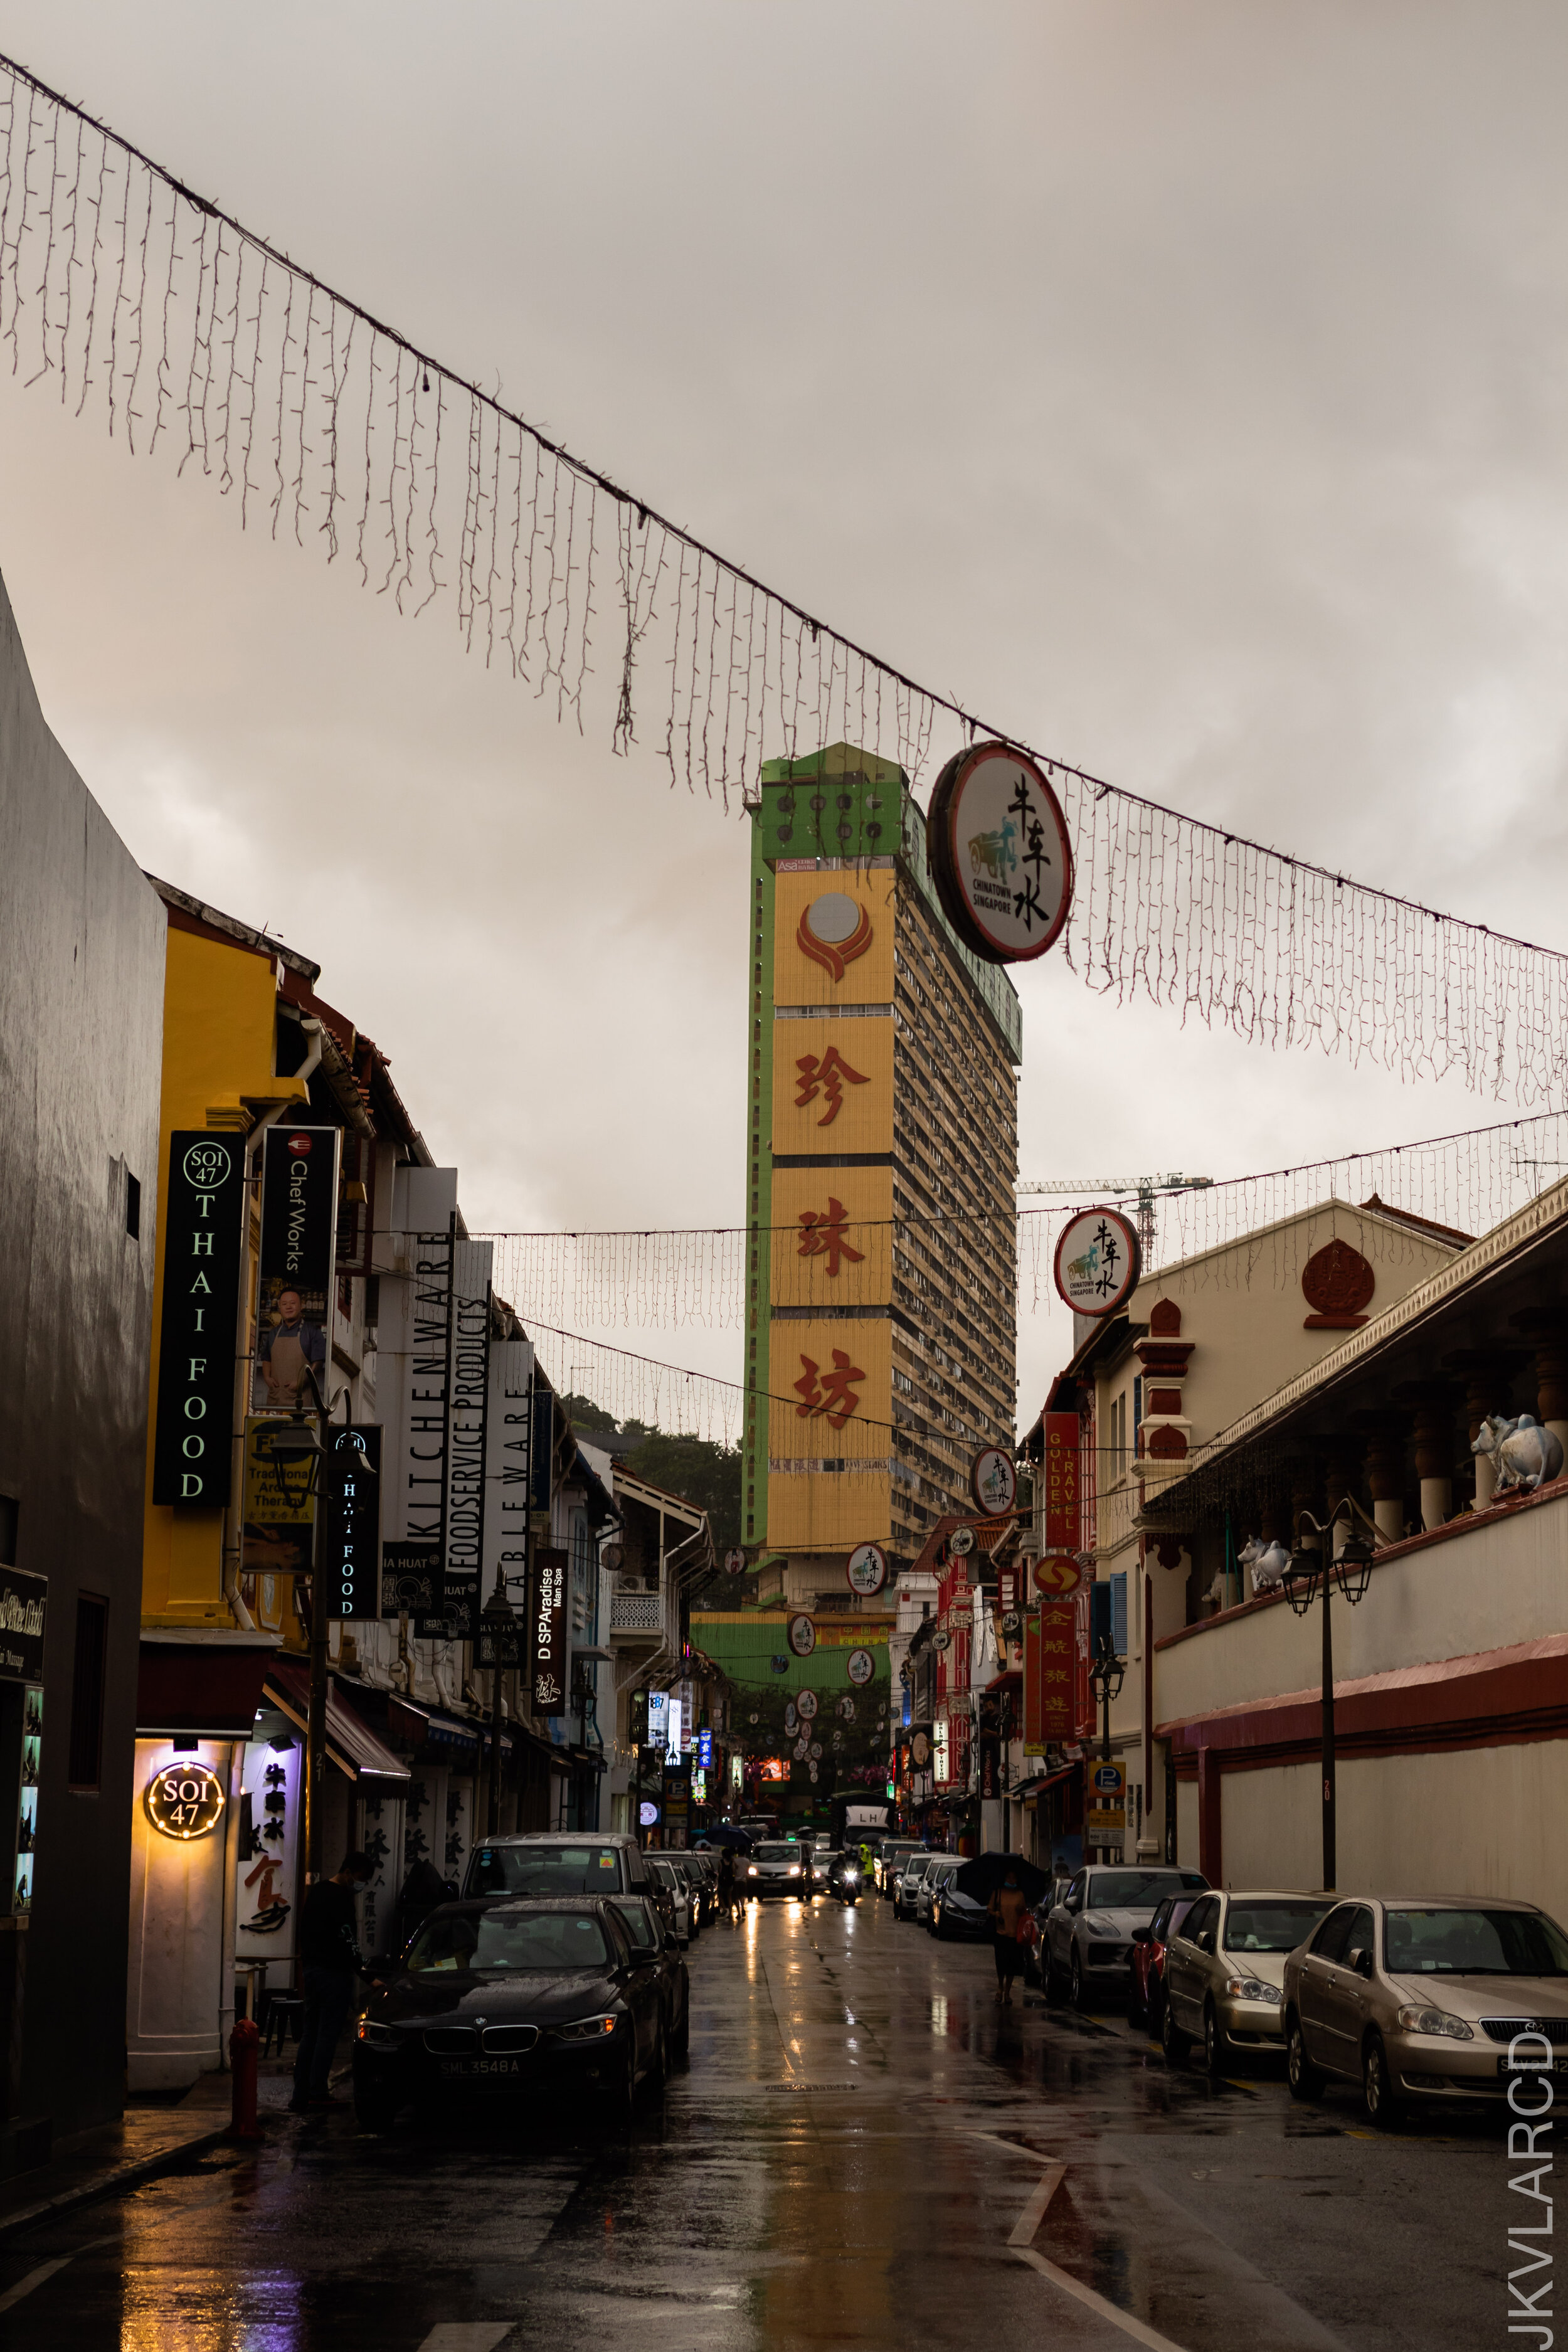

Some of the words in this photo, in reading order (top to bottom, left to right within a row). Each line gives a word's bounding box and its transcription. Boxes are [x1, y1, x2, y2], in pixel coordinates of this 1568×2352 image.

[973, 878, 1011, 899] CHINATOWN
[973, 894, 1011, 914] SINGAPORE
[191, 1151, 223, 1167] SOI
[196, 1167, 216, 1183] 47
[289, 1160, 308, 1205] Chef
[287, 1208, 306, 1272] Works
[793, 1046, 871, 1430] 珍珠坊
[189, 1195, 216, 1332] THAI
[1070, 1281, 1094, 1289] CHINATOWN
[1070, 1288, 1094, 1296] SINGAPORE
[455, 1298, 489, 1409] PRODUCTS
[407, 1234, 450, 1538] KITCHENWARE
[180, 1358, 208, 1497] FOOD
[1050, 1433, 1061, 1515] GOLDEN
[449, 1422, 483, 1569] FOODSERVICE
[1064, 1446, 1074, 1529] TRAVEL
[398, 1558, 427, 1568] HUAT
[341, 1545, 354, 1614] FOOD
[553, 1568, 563, 1586] Spa
[538, 1568, 553, 1644] SPAradise
[553, 1591, 562, 1608] Man
[538, 1646, 551, 1660] D
[1100, 1768, 1116, 1786] P
[163, 1780, 209, 1803] SOI
[170, 1804, 199, 1826] 47
